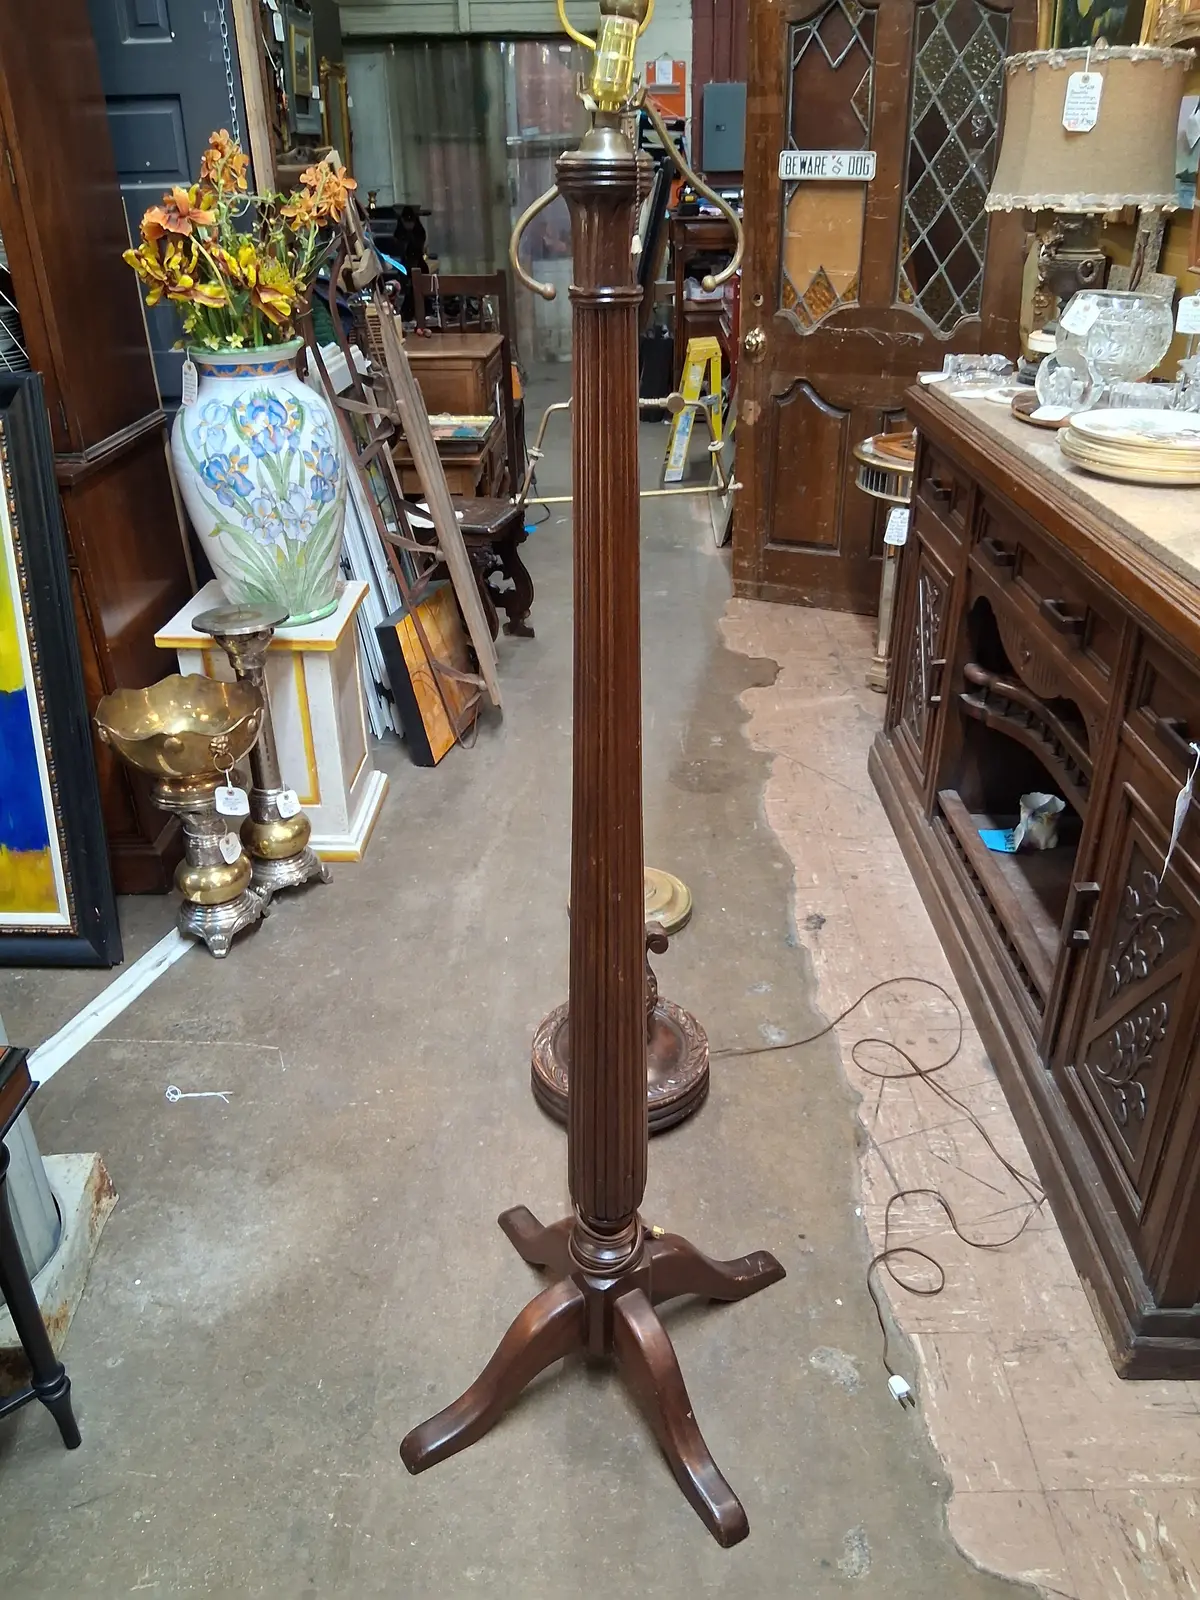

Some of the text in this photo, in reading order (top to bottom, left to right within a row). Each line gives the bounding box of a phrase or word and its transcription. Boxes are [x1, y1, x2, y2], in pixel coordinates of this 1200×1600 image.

[785, 156, 871, 176] BEWARE OF DOG
